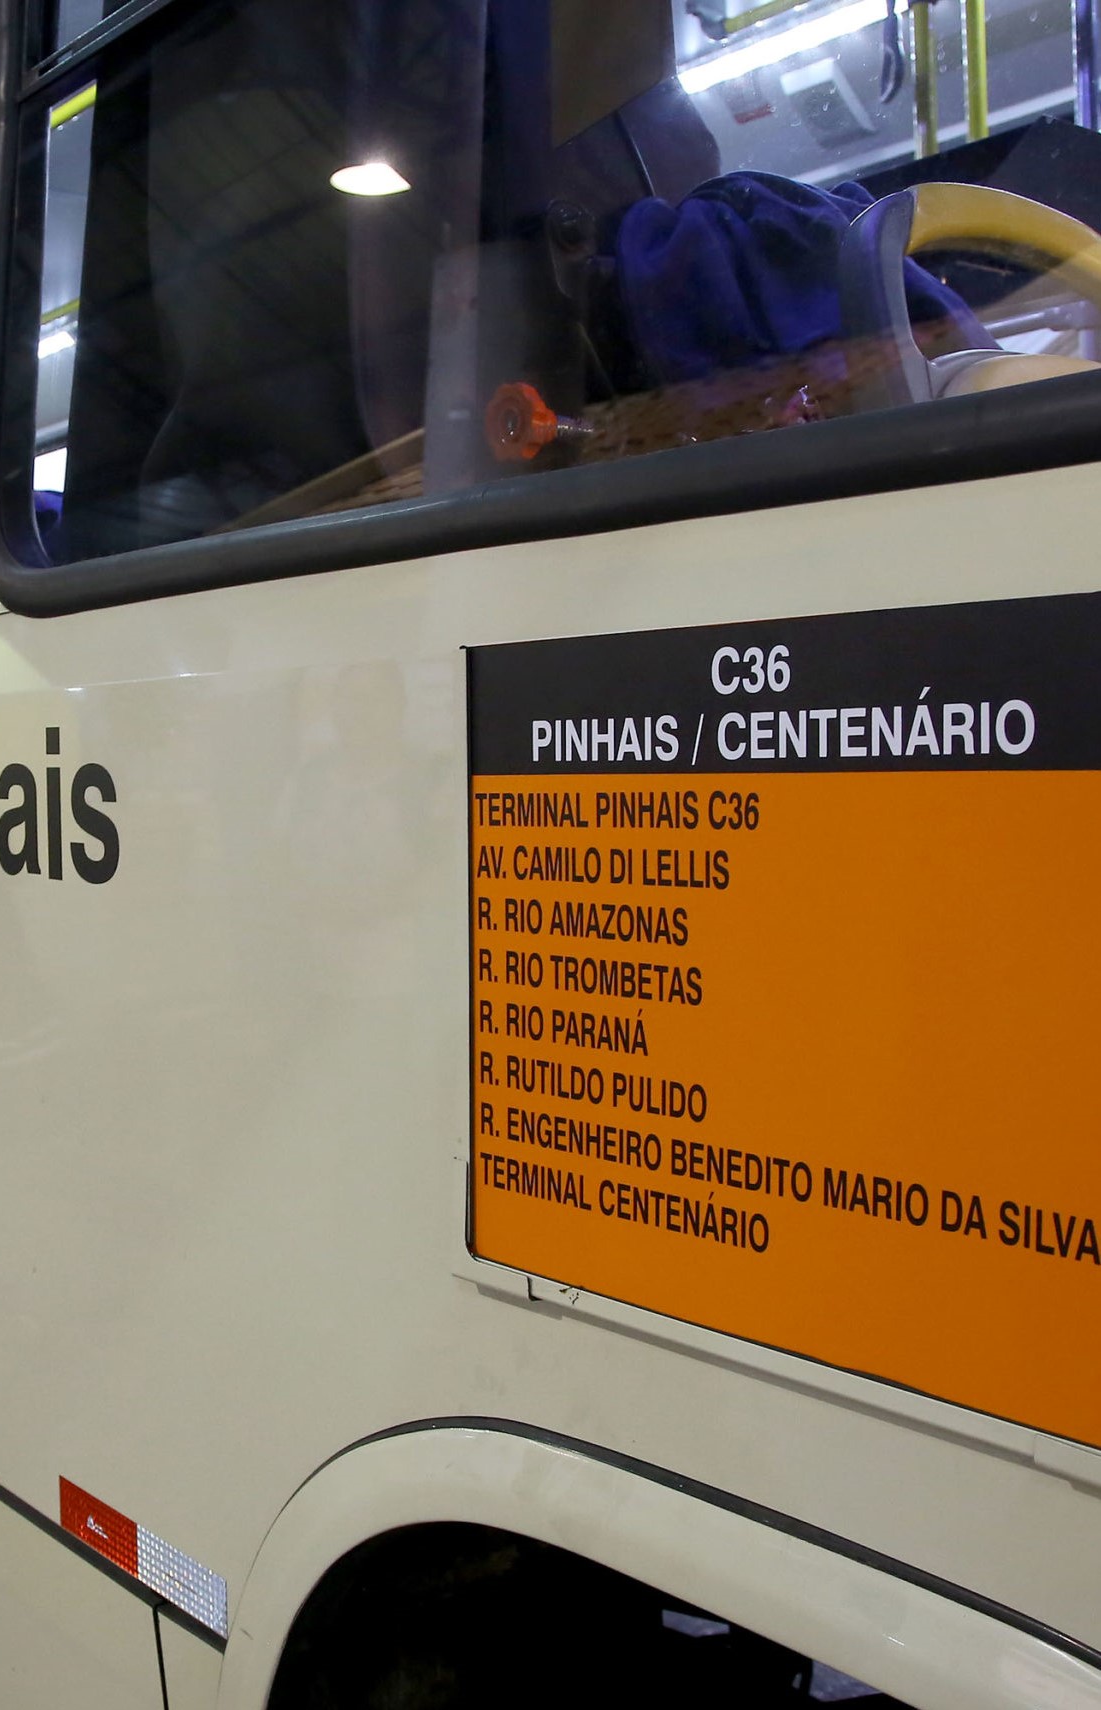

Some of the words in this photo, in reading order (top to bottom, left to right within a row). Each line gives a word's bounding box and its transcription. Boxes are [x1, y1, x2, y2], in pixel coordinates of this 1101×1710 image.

[711, 644, 791, 695] C36
[532, 714, 679, 762] PINHAIS
[691, 713, 705, 766] /
[717, 686, 1036, 761] CENTENÁRIO
[475, 792, 589, 828] TERMINAL
[596, 791, 699, 830] PINHAIS
[708, 790, 760, 831] C36
[477, 845, 507, 881] AV.
[513, 846, 602, 884] CAMILO
[610, 848, 634, 885] DI
[642, 849, 730, 890] LELLIS
[478, 896, 499, 931] R.
[504, 898, 544, 936] RIO
[549, 901, 689, 947] AMAZONAS
[479, 948, 499, 983] R.
[505, 950, 544, 988] RIO
[549, 954, 703, 1006] TROMBETAS
[479, 999, 499, 1035] R.
[506, 1002, 544, 1041] RIO
[552, 1009, 649, 1057] PARANÁ
[480, 1051, 500, 1086] R.
[506, 1055, 605, 1105] RUTILDO
[612, 1072, 708, 1123] PULIDO
[480, 1101, 500, 1138] R.
[507, 1107, 662, 1171] ENGENHEIRO
[671, 1138, 813, 1203] BENEDITO
[823, 1167, 929, 1227] MARIO
[940, 1190, 987, 1240] DA
[998, 1200, 1101, 1266] SILVA
[480, 1151, 592, 1212] TERMINAL
[598, 1179, 770, 1254] CENTENÁRIO
